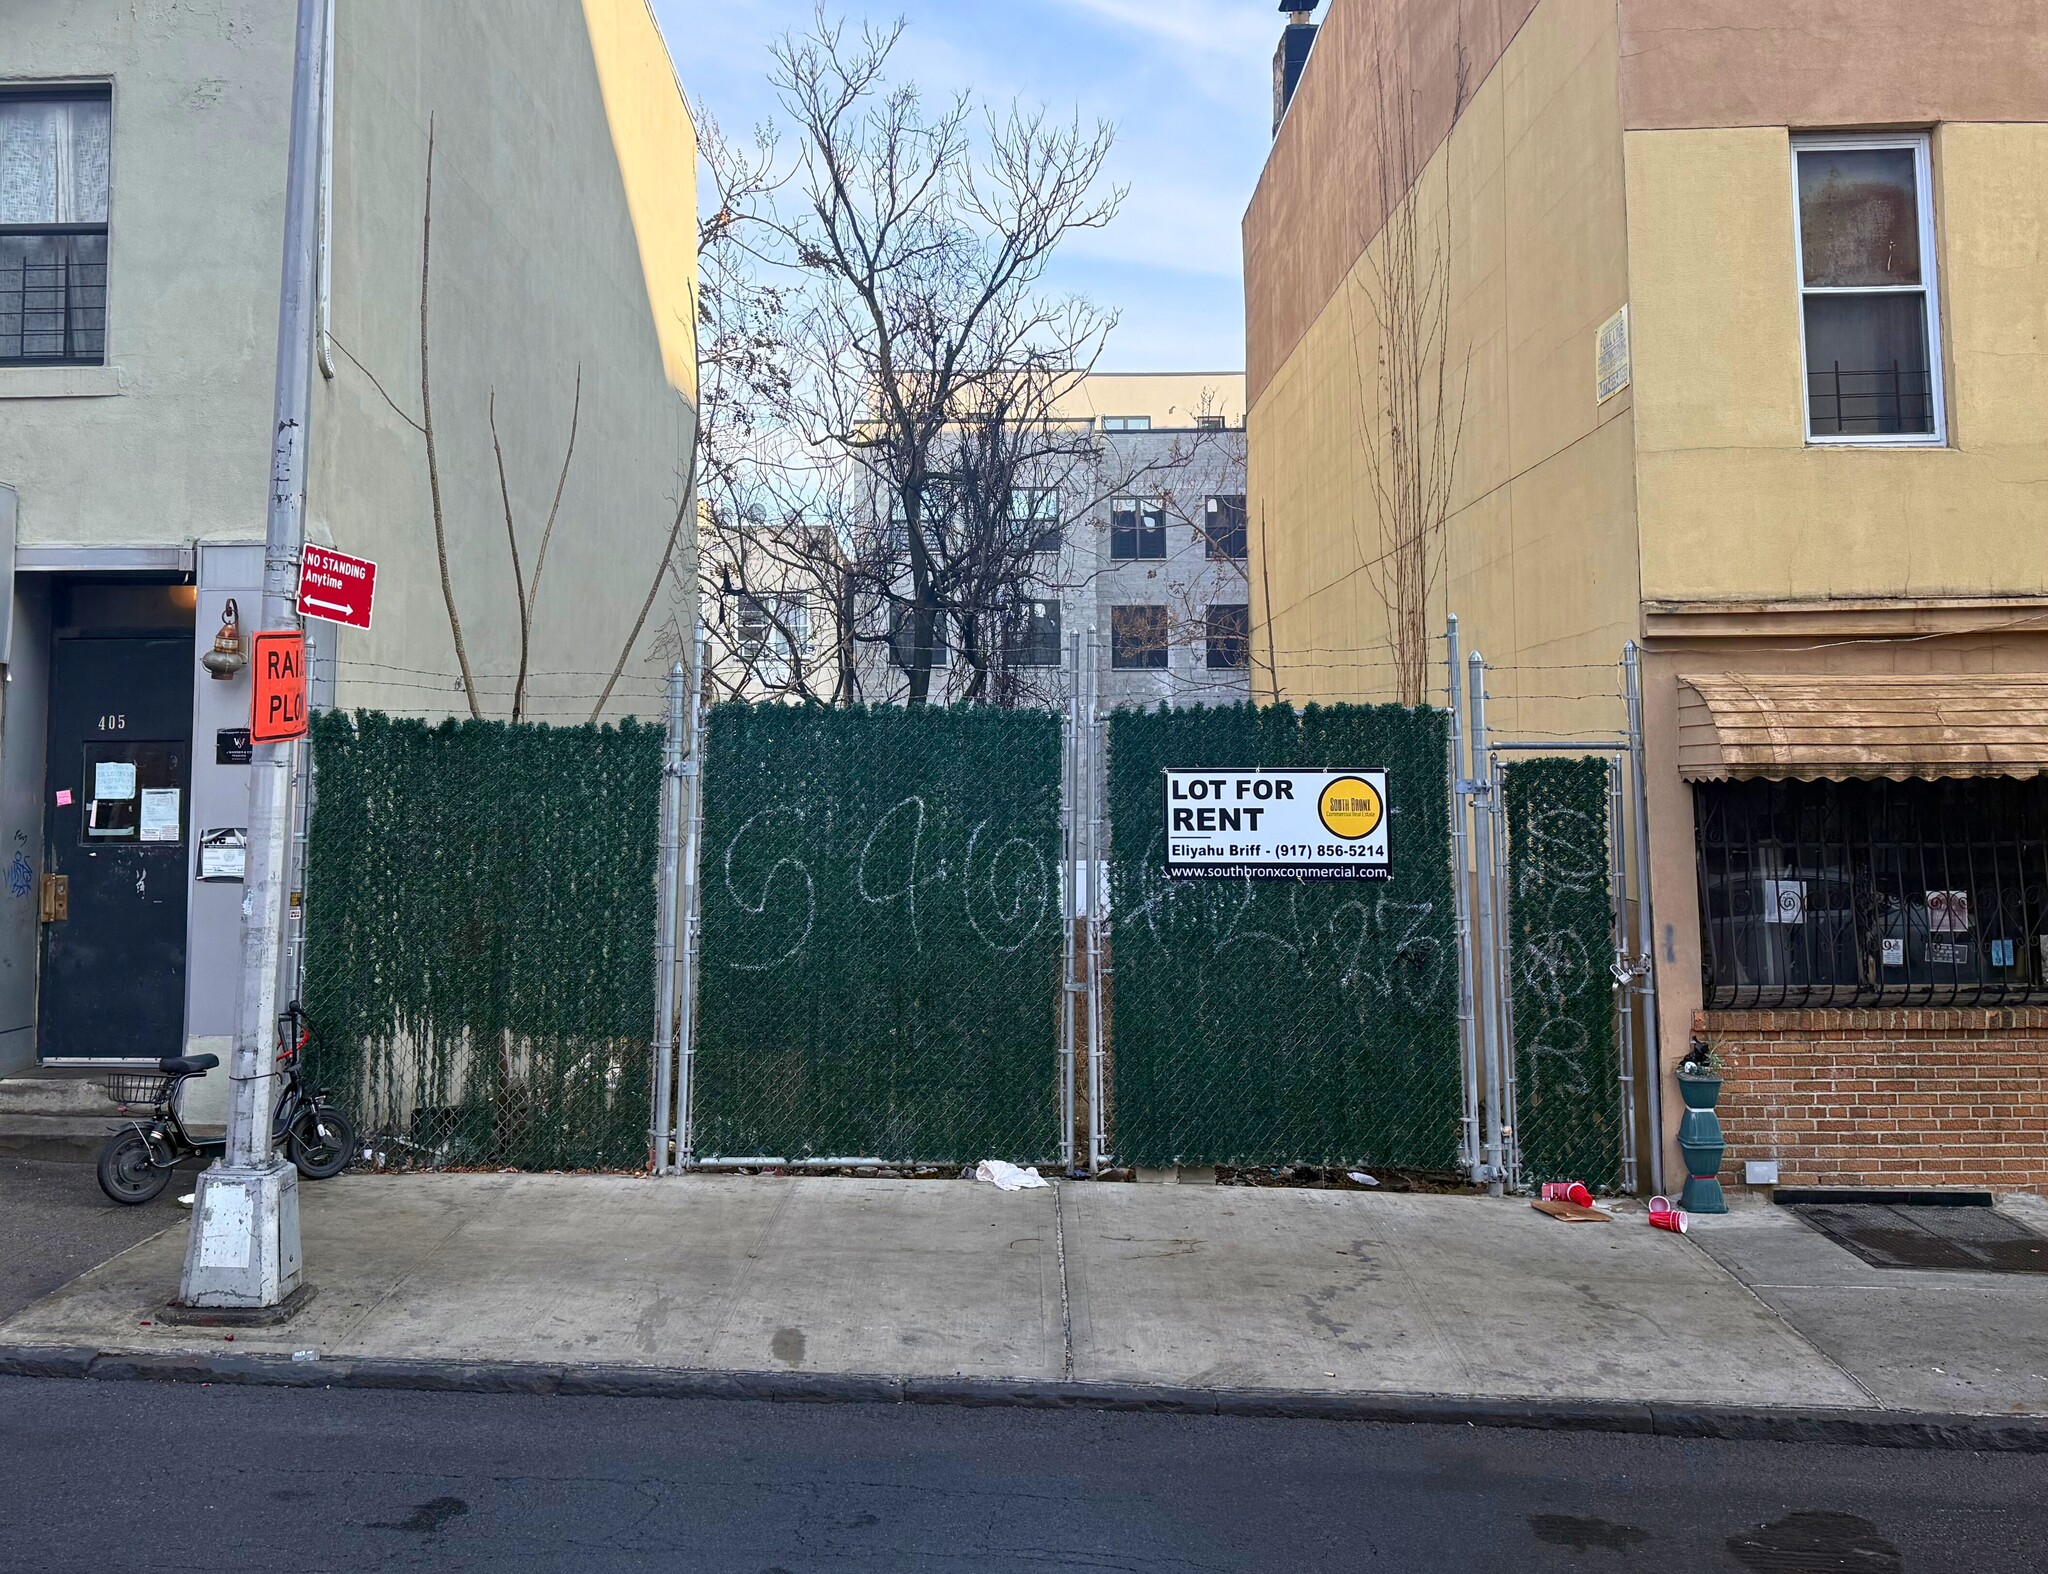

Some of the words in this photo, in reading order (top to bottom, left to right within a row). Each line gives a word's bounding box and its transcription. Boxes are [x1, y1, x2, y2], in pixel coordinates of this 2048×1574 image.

[306, 552, 321, 568] NO
[322, 558, 366, 580] STANDING
[305, 569, 343, 590] Anytime
[98, 714, 125, 730] 405
[1172, 780, 1226, 800] LOT
[1236, 780, 1294, 800] FOR
[1330, 797, 1350, 811] SOUTH
[1351, 797, 1371, 811] BRONX
[1173, 807, 1264, 832] RENT
[1172, 844, 1224, 859] Eliyahu
[1229, 844, 1261, 857] Briff
[1275, 844, 1312, 860] (917)
[1317, 844, 1384, 857] 856-5214
[1171, 865, 1387, 879] www.southbronxcommercial.com
